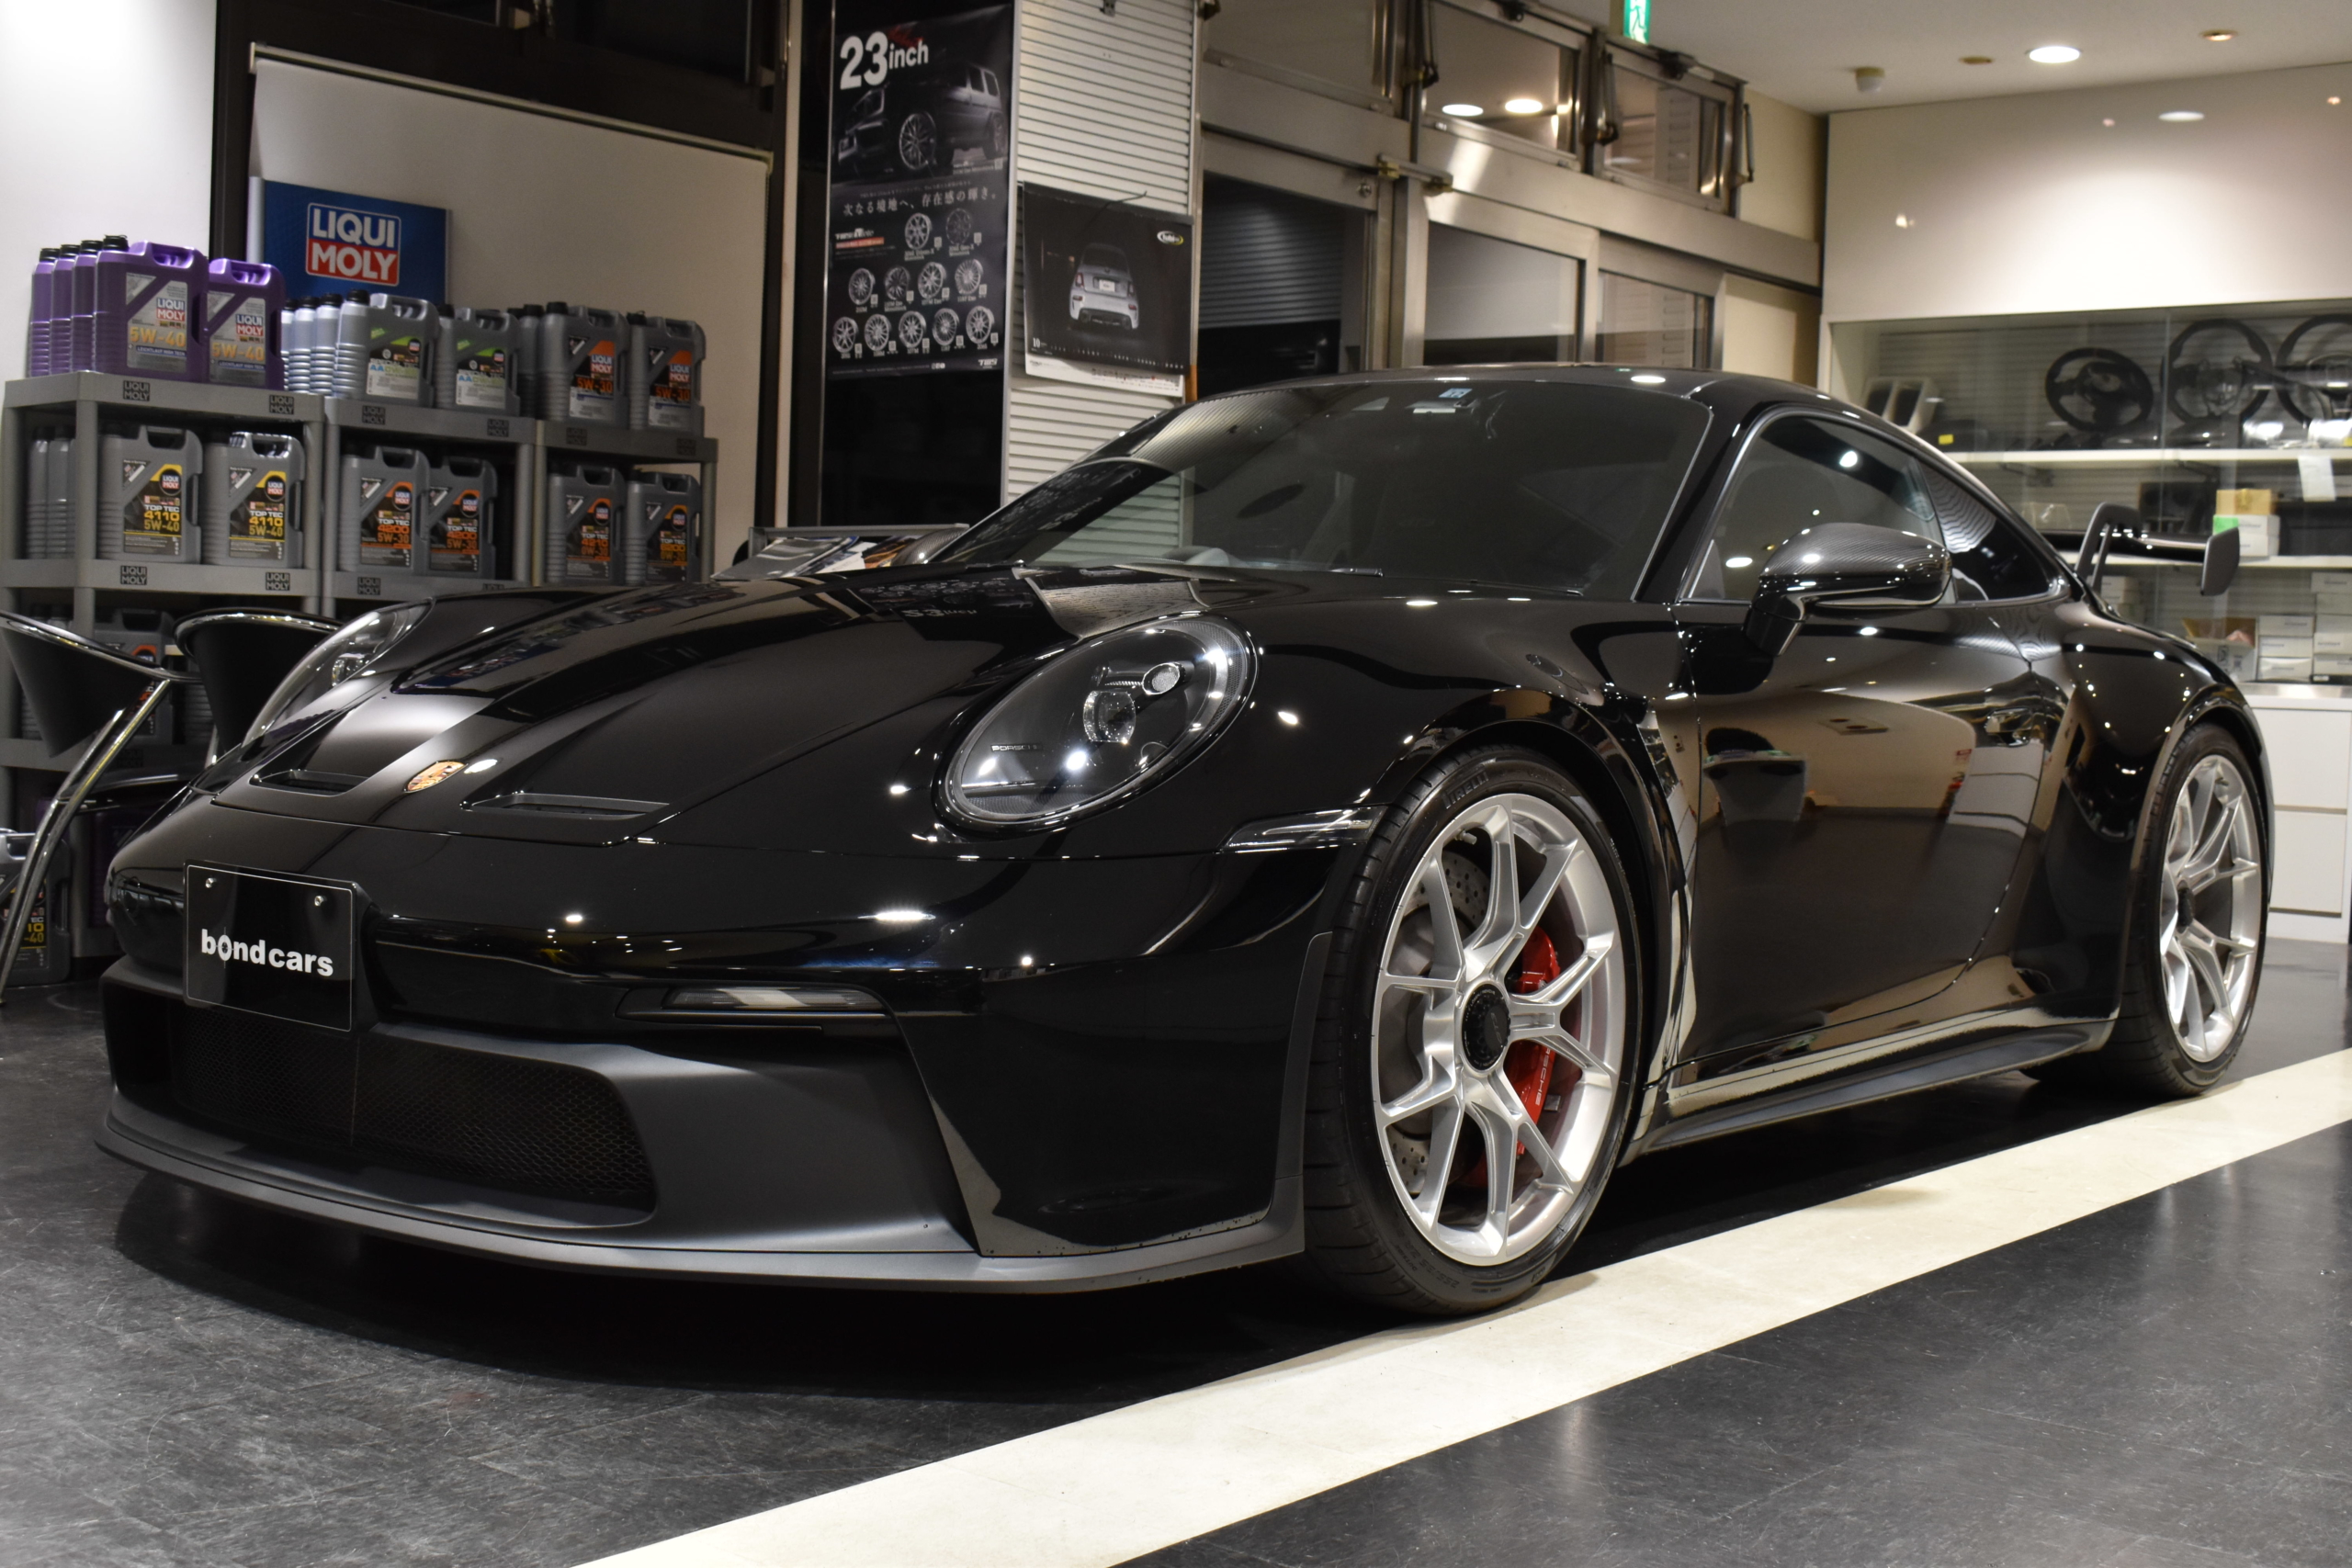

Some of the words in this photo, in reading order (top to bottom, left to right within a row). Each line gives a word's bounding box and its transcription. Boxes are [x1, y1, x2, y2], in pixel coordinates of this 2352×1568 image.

[312, 208, 395, 248] LIQUI
[311, 242, 397, 280] MOLY
[157, 298, 185, 310] LIQUI
[157, 309, 186, 321] MOLY
[236, 313, 263, 325] LIQUI
[237, 324, 264, 336] MOLY
[130, 326, 186, 347] 5W-40
[1033, 337, 1040, 348] 10
[212, 342, 265, 361] 5W-40
[591, 355, 612, 364] LIQUI
[591, 363, 613, 374] MOLY
[670, 373, 689, 382] MOLY
[124, 381, 149, 392] LIQUI
[577, 378, 613, 393] 5W-30
[124, 390, 149, 401] MOLY
[655, 386, 690, 401] 5W-30
[271, 396, 293, 405] LIQUI
[270, 404, 294, 414] MOLY
[363, 415, 386, 424] MOLY
[143, 511, 180, 522] 4110
[249, 516, 283, 527] 4110
[143, 519, 180, 532] 5W-40
[249, 525, 283, 537] 5W-40
[378, 525, 410, 535] 4200
[378, 533, 410, 544] 5W-30
[447, 531, 478, 540] 4200
[447, 538, 478, 549] 5W-30
[582, 538, 608, 547] 4210
[121, 566, 147, 576] LIQUI
[121, 575, 147, 585] MOLY
[266, 573, 289, 582] LIQUI
[359, 577, 380, 587] LIQUI
[266, 581, 290, 591] MOLY
[358, 586, 380, 595] MOLY
